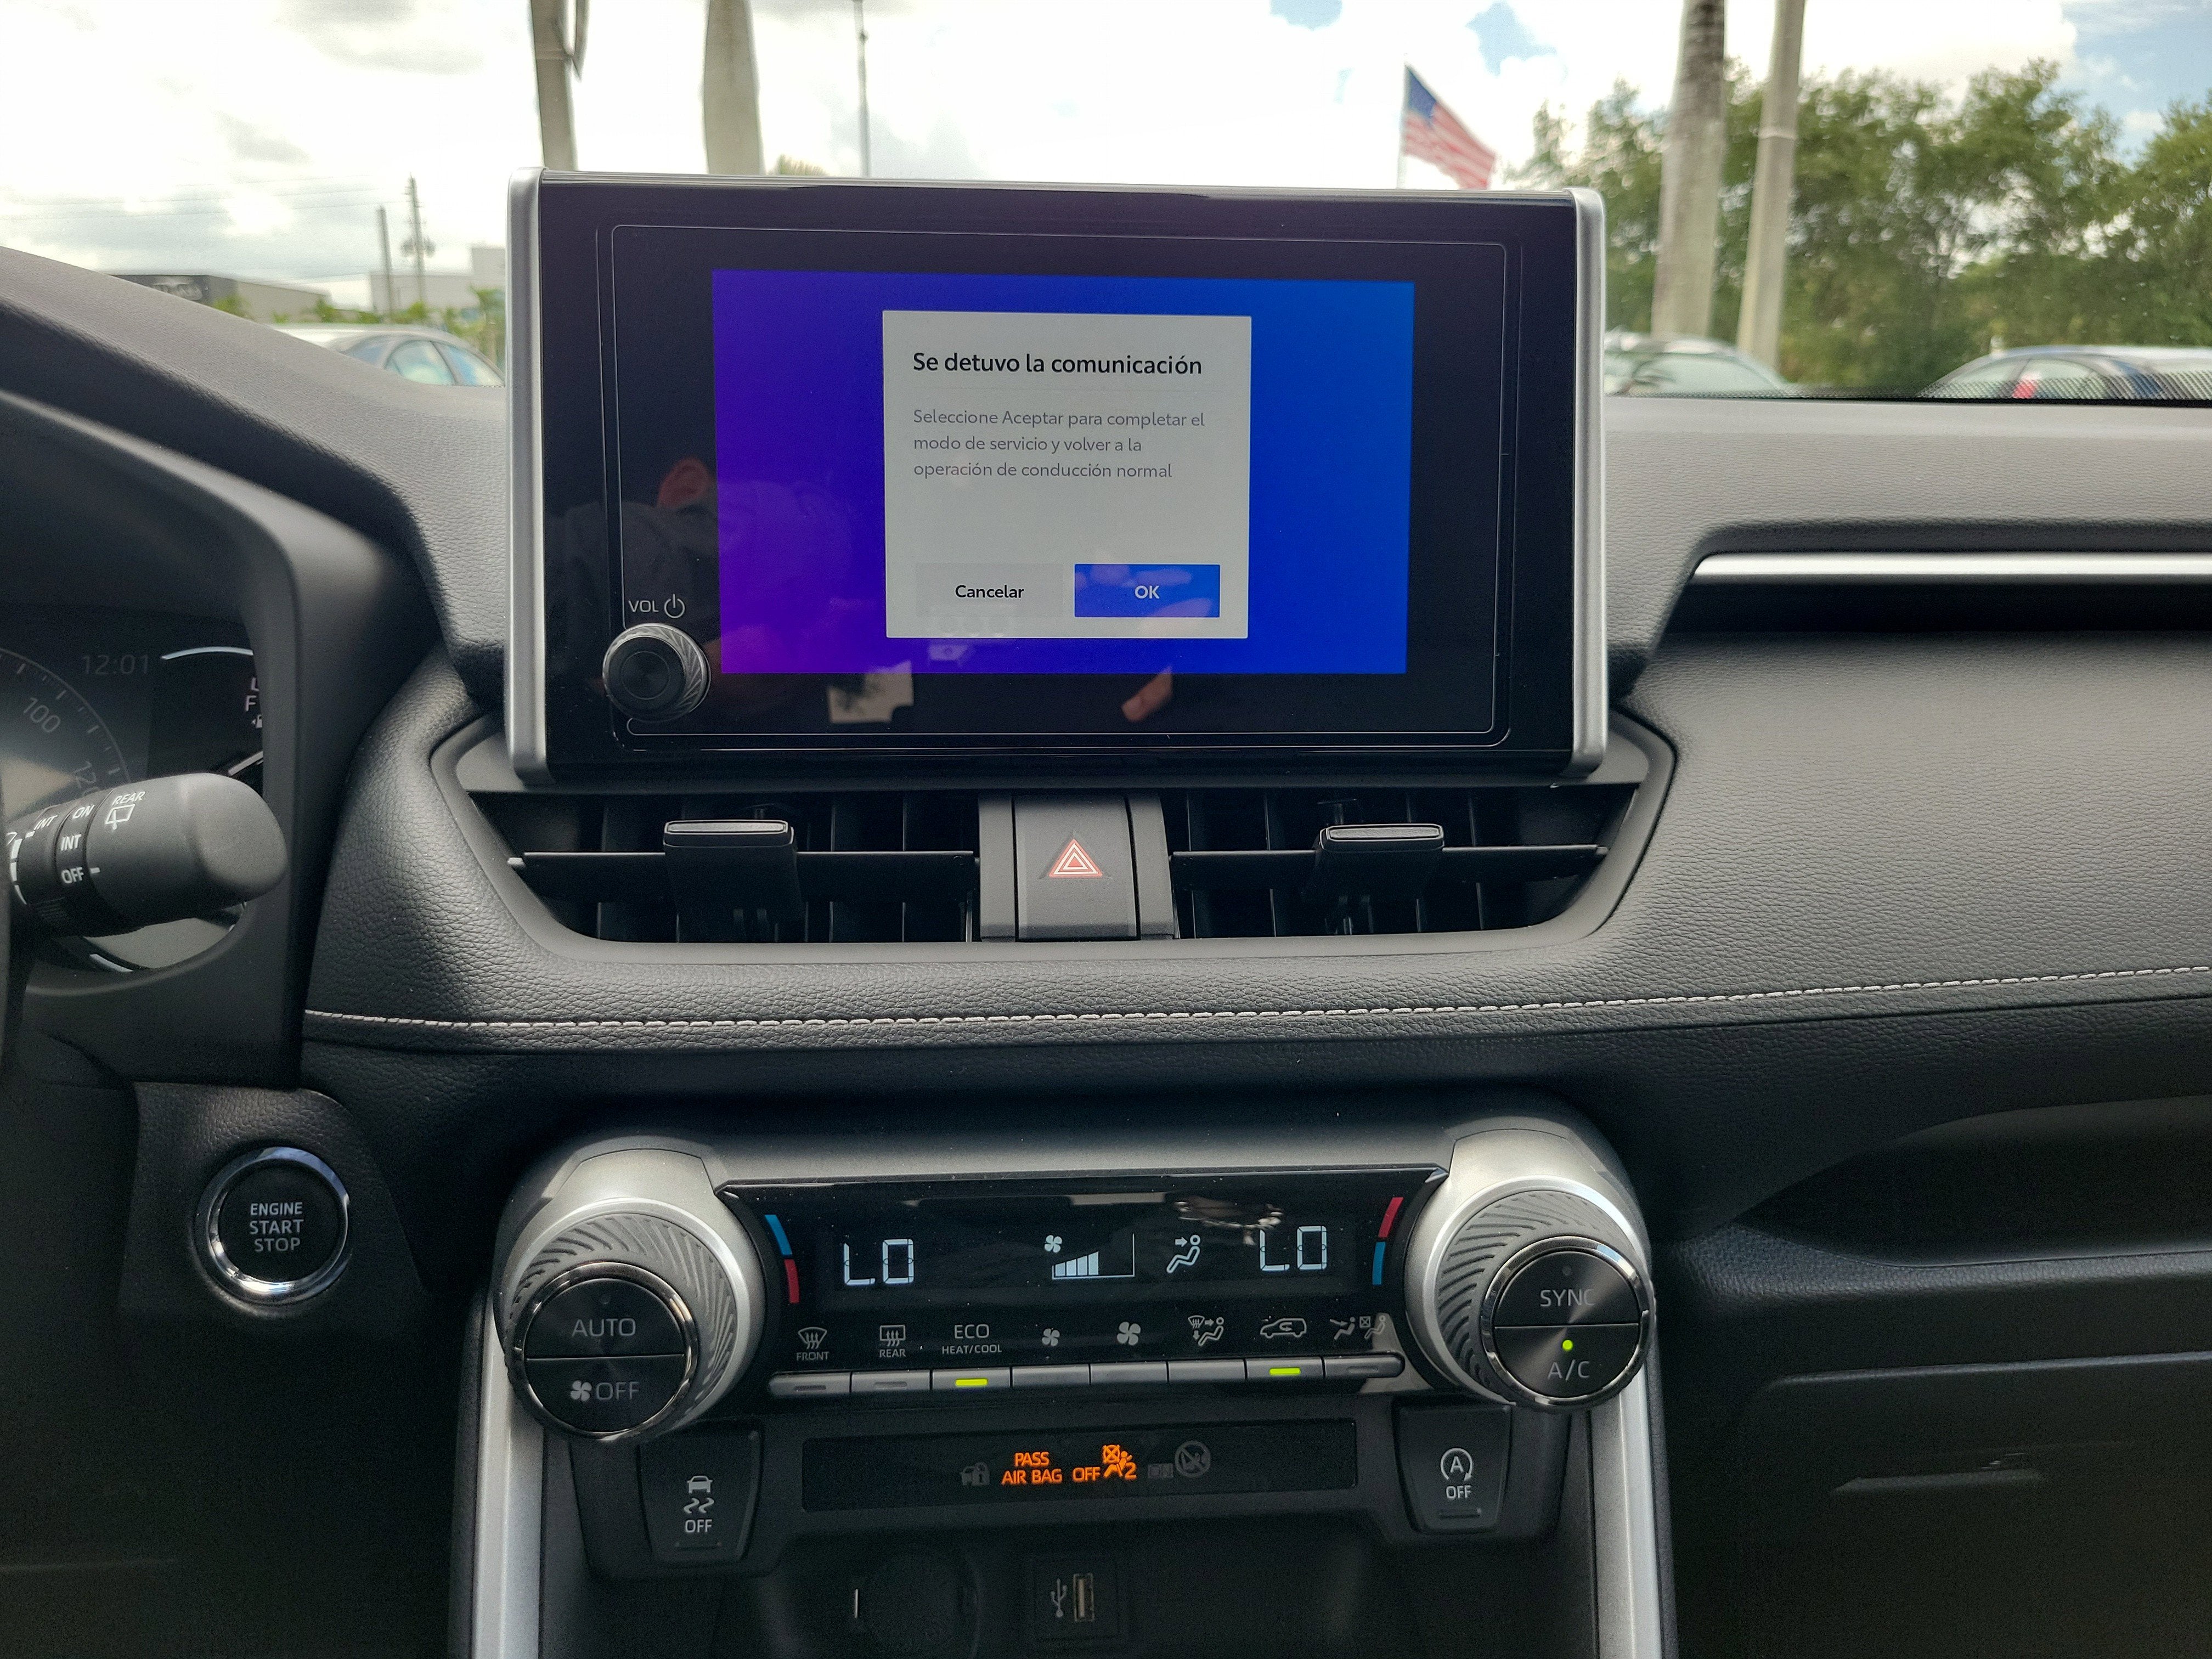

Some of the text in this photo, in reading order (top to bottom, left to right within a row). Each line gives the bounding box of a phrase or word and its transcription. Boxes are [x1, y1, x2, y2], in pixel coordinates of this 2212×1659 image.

[913, 353, 1201, 375] Se detuvo la comunicación
[913, 410, 1205, 429] Seleccione Aceptar para completar el
[913, 437, 1141, 454] modo de servicio y volver a la
[913, 462, 1172, 479] operación de conducción normal
[955, 585, 1024, 599] Cancelar
[1135, 585, 1160, 599] OK
[629, 600, 659, 612] VOL
[82, 654, 148, 675] 12:01
[245, 696, 257, 711] F
[23, 697, 61, 733] 100
[112, 791, 146, 805] REAR
[72, 805, 95, 819] ON
[33, 815, 58, 830] INT
[61, 834, 82, 851] INT
[61, 867, 83, 884] OFF
[251, 1202, 302, 1216] ENGINE
[250, 1219, 304, 1234] START
[255, 1238, 300, 1252] STOP
[1539, 1289, 1594, 1307] SYNC
[572, 1318, 636, 1336] AUTO
[954, 1324, 989, 1339] ECO
[796, 1351, 830, 1361] FRONT
[879, 1348, 906, 1358] REAR
[941, 1344, 1002, 1354] HEAT/COOL
[1547, 1359, 1590, 1381] A/C
[596, 1381, 640, 1401] OFF
[1014, 1452, 1049, 1466] PASS
[1450, 1456, 1464, 1473] A
[1001, 1462, 1137, 1485] AIR BAG OFF 2
[1446, 1485, 1472, 1499] OFF
[685, 1519, 712, 1533] OFF
